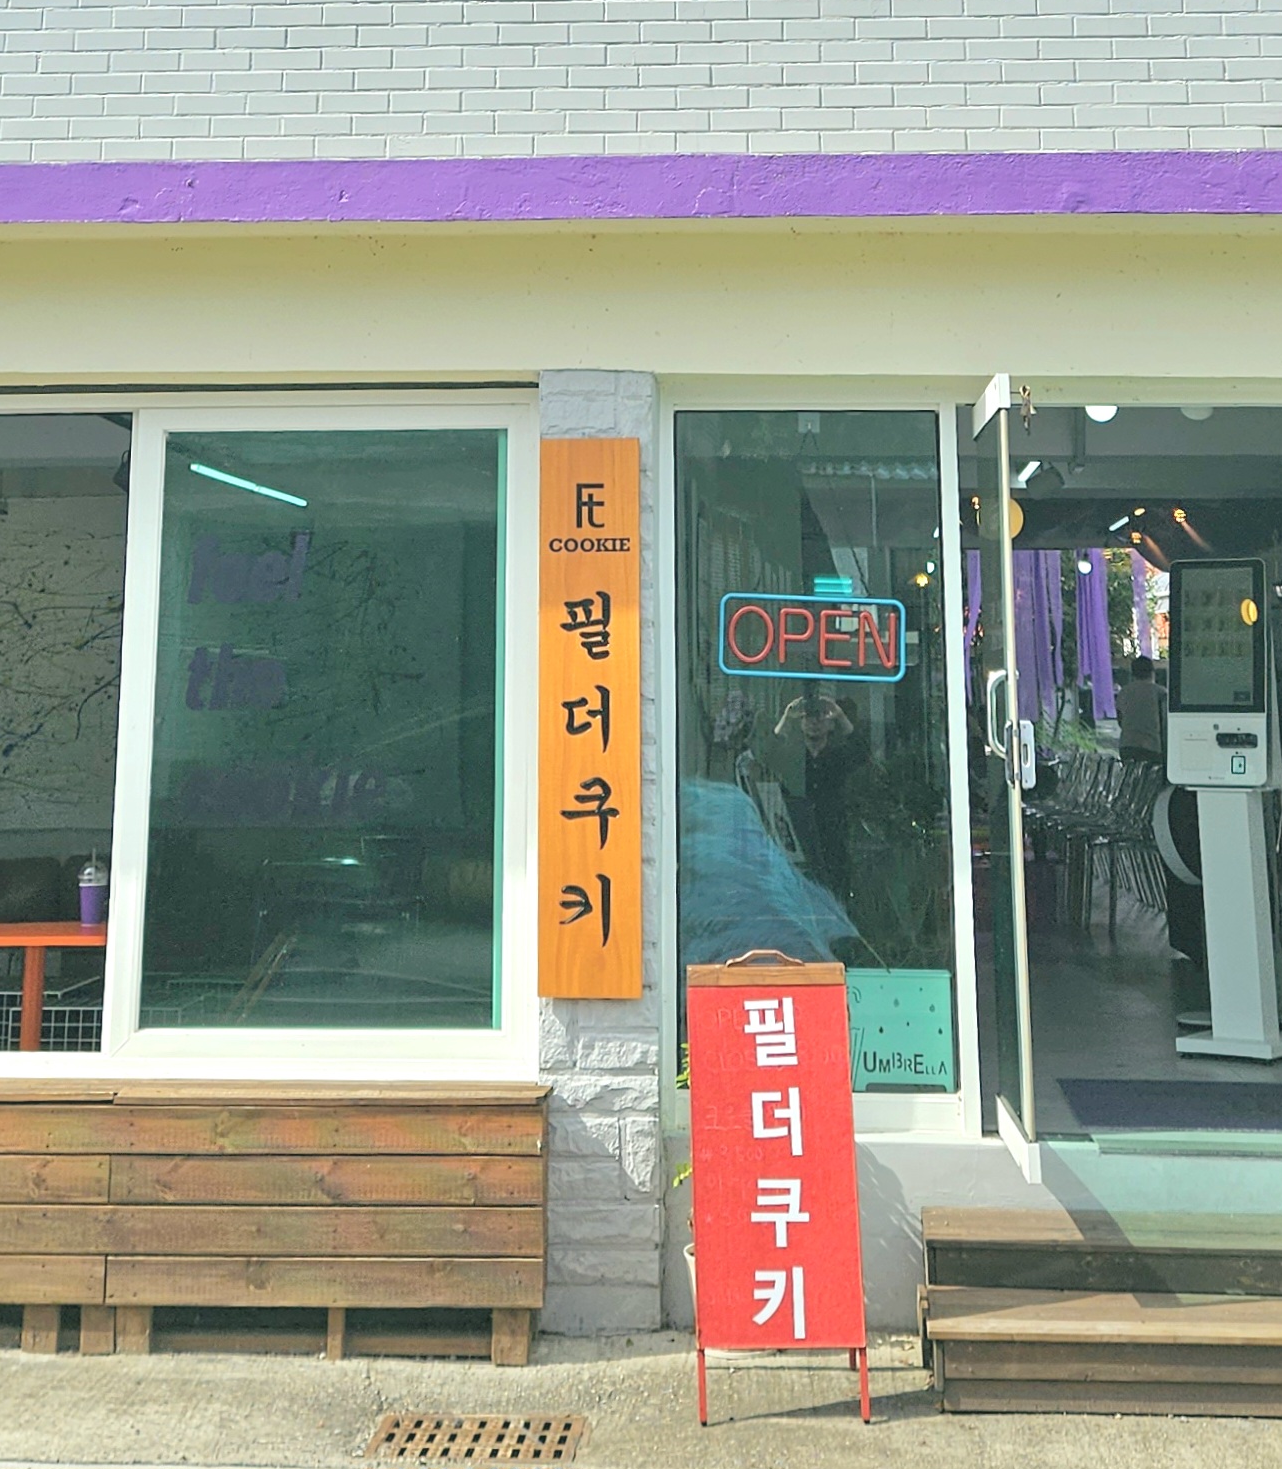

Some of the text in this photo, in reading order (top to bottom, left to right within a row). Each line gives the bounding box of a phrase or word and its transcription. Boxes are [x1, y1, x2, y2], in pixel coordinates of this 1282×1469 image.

[548, 537, 631, 553] COOKIE
[728, 605, 897, 669] OPEN
[743, 996, 810, 1340] 필더쿠키
